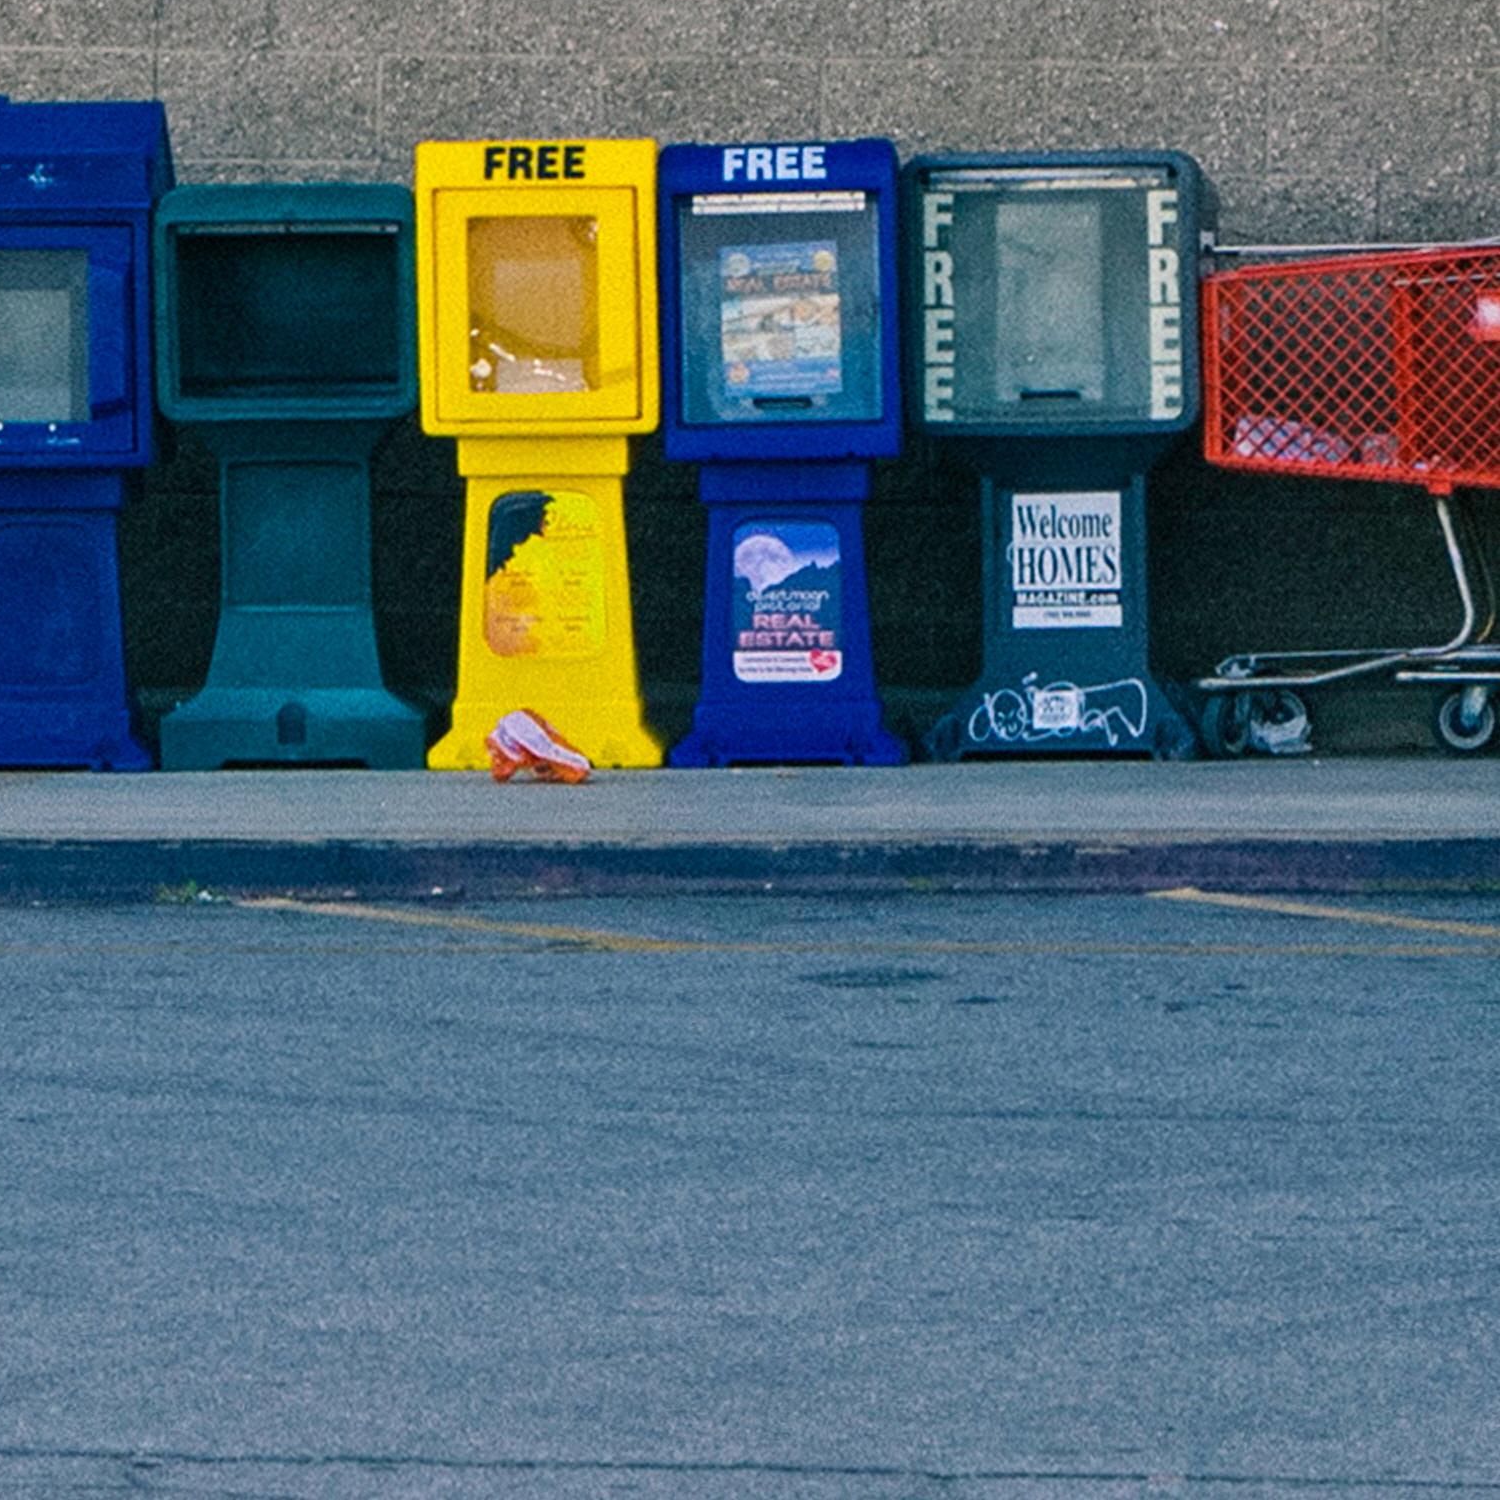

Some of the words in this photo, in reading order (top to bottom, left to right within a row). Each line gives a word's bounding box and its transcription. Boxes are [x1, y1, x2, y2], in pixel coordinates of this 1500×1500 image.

[484, 146, 585, 180] FREE
[723, 147, 826, 181] FREE
[923, 193, 955, 422] FREE
[1147, 190, 1183, 420] FREE
[1017, 504, 1112, 539] Welcome
[1018, 544, 1117, 585] HOMES
[1016, 591, 1119, 605] MAGAZINE.com
[753, 613, 820, 629] REAL
[739, 631, 835, 647] ESTATE
